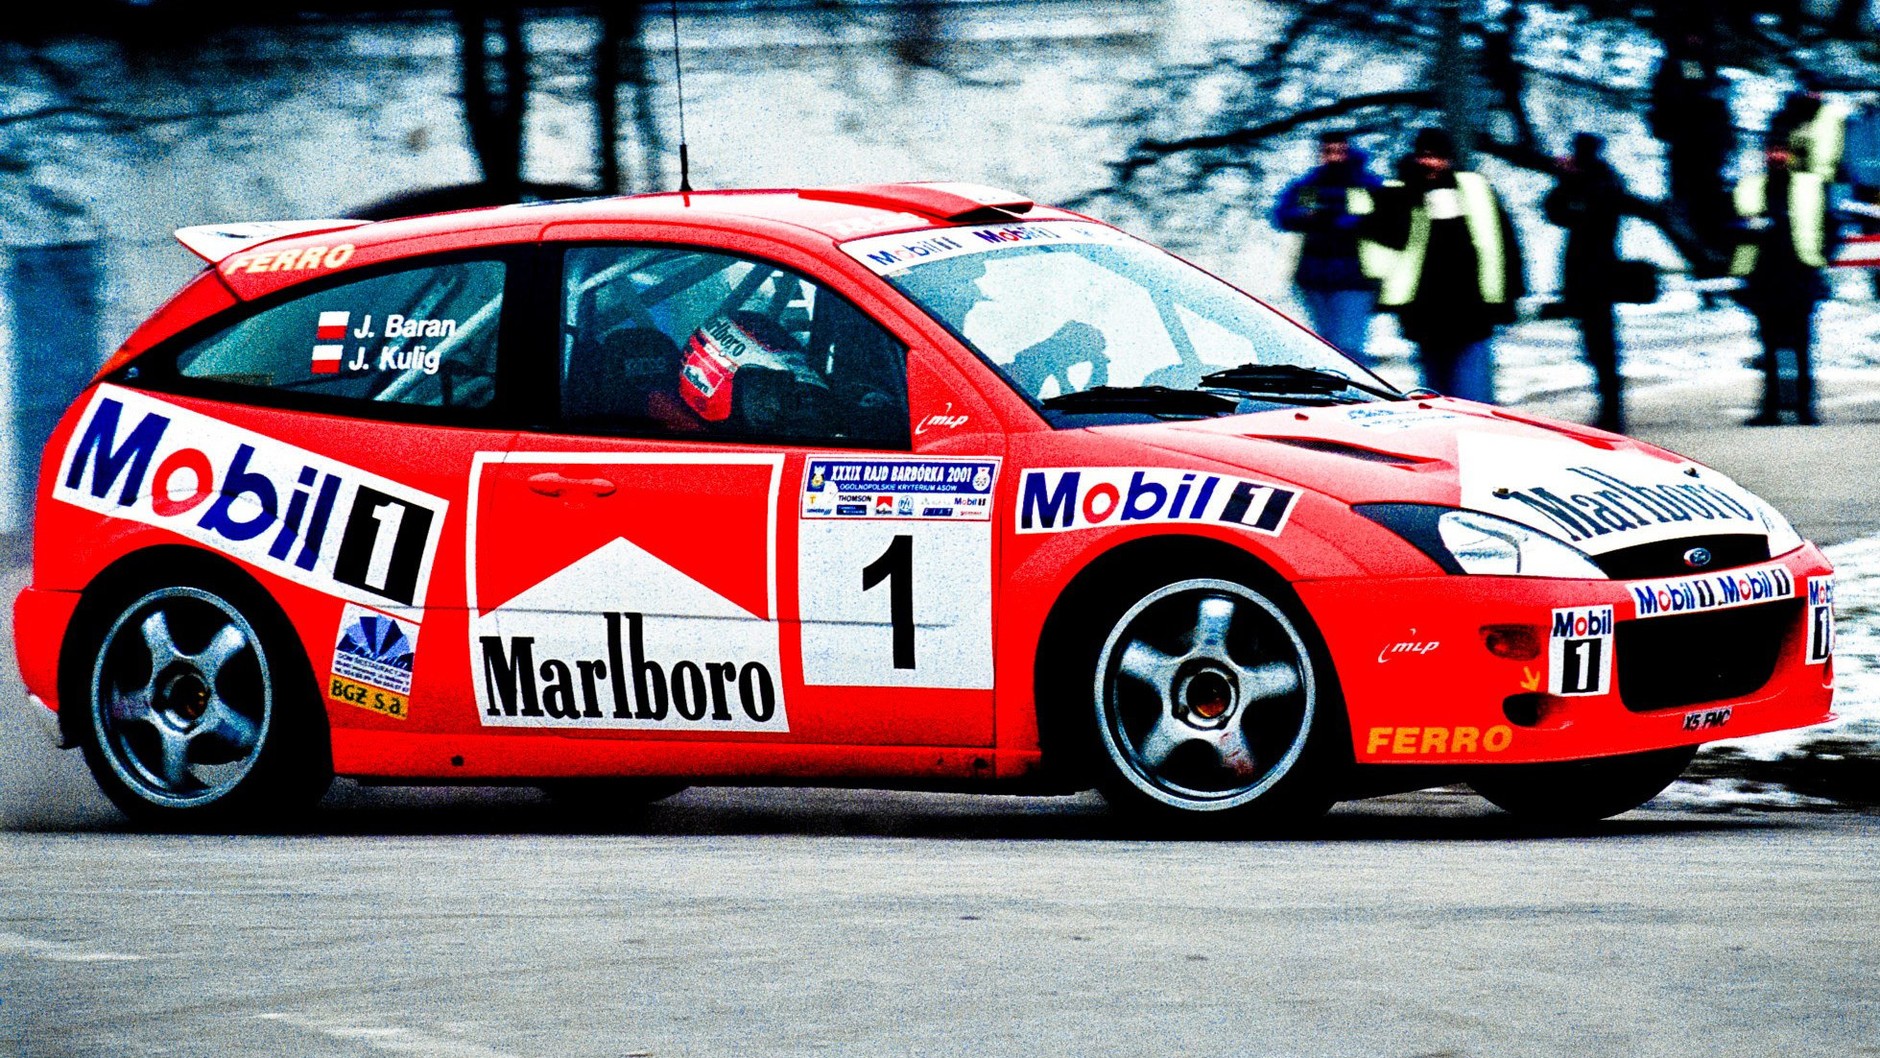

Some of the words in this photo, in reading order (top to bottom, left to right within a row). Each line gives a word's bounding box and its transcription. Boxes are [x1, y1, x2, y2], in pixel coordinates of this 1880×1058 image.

[223, 243, 356, 275] FERRO
[866, 241, 943, 265] Mobil
[354, 314, 375, 338] J.
[385, 314, 457, 338] Baran
[703, 317, 747, 357] rlboro
[348, 346, 369, 371] J.
[379, 345, 442, 374] Kulig
[64, 397, 342, 572] Mobil
[830, 465, 862, 481] XXXIX
[863, 465, 889, 481] RAJD
[891, 463, 945, 483] BARBÓRKA
[946, 466, 972, 483] 2001
[897, 483, 936, 491] KRYTERIUM
[1021, 471, 1221, 529] Mobil
[1510, 466, 1755, 541] Marlboro
[862, 534, 916, 670] 1
[1635, 582, 1695, 615] Mobil
[1717, 570, 1772, 603] Mobil
[1809, 579, 1834, 606] Mob
[1553, 609, 1612, 637] Mobil
[479, 612, 776, 723] Marlboro
[1684, 713, 1701, 730] X5
[1703, 709, 1731, 728] FMC
[1366, 724, 1513, 754] FERRO
